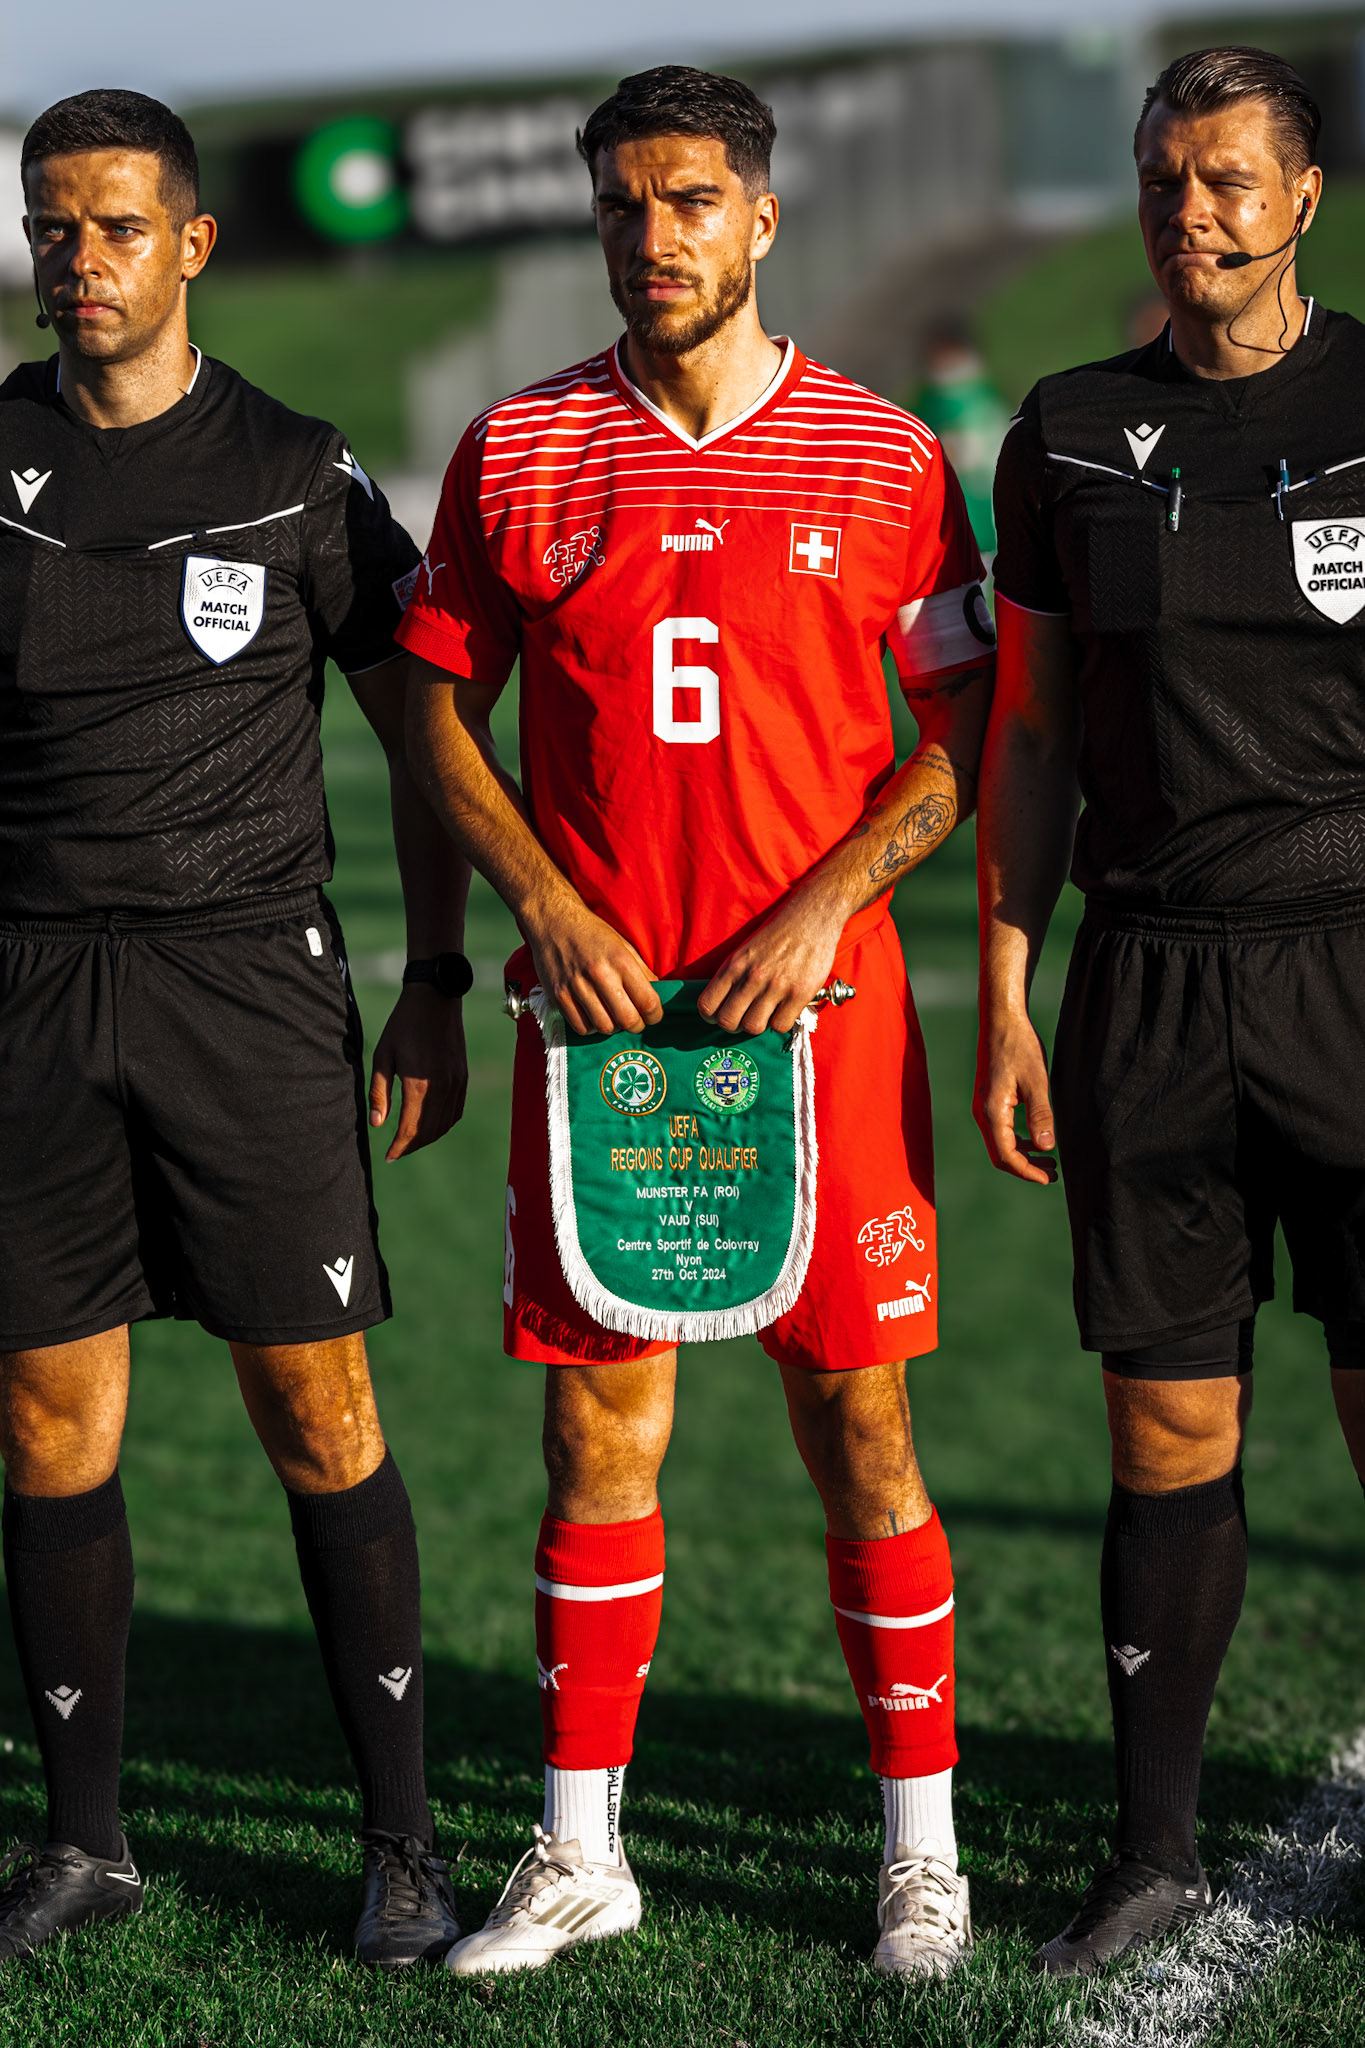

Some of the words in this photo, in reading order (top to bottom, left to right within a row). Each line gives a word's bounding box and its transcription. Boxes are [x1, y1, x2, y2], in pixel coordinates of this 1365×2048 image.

[661, 534, 714, 552] PUMA
[1308, 529, 1359, 549] UEFA
[1312, 560, 1363, 575] MATCH
[201, 571, 248, 591] UEFA
[200, 600, 248, 616] MATCH
[193, 615, 251, 632] OFFICIAL
[652, 616, 720, 744] 6
[605, 1052, 660, 1075] IRELAND
[737, 1053, 752, 1069] na
[612, 1100, 656, 1113] FOOTBALL
[669, 1115, 699, 1138] UEFA
[610, 1147, 663, 1171] REGIONS
[668, 1146, 693, 1171] CUP
[699, 1146, 758, 1171] QUALIFIER
[636, 1186, 688, 1199] MUNSTER
[693, 1186, 708, 1198] FA
[714, 1185, 740, 1200] (ROI)
[685, 1200, 693, 1212] V
[659, 1214, 690, 1226] VAUD
[695, 1214, 719, 1228] (SUI)
[617, 1238, 652, 1251] Centre
[657, 1238, 692, 1253] Sportif
[697, 1238, 709, 1250] de
[714, 1238, 759, 1253] Colovray
[676, 1253, 702, 1268] Nyon
[651, 1268, 674, 1281] 27th
[679, 1268, 697, 1280] Oct
[702, 1268, 726, 1280] 2024
[877, 1294, 925, 1322] PUMA
[868, 1694, 930, 1711] PUMA
